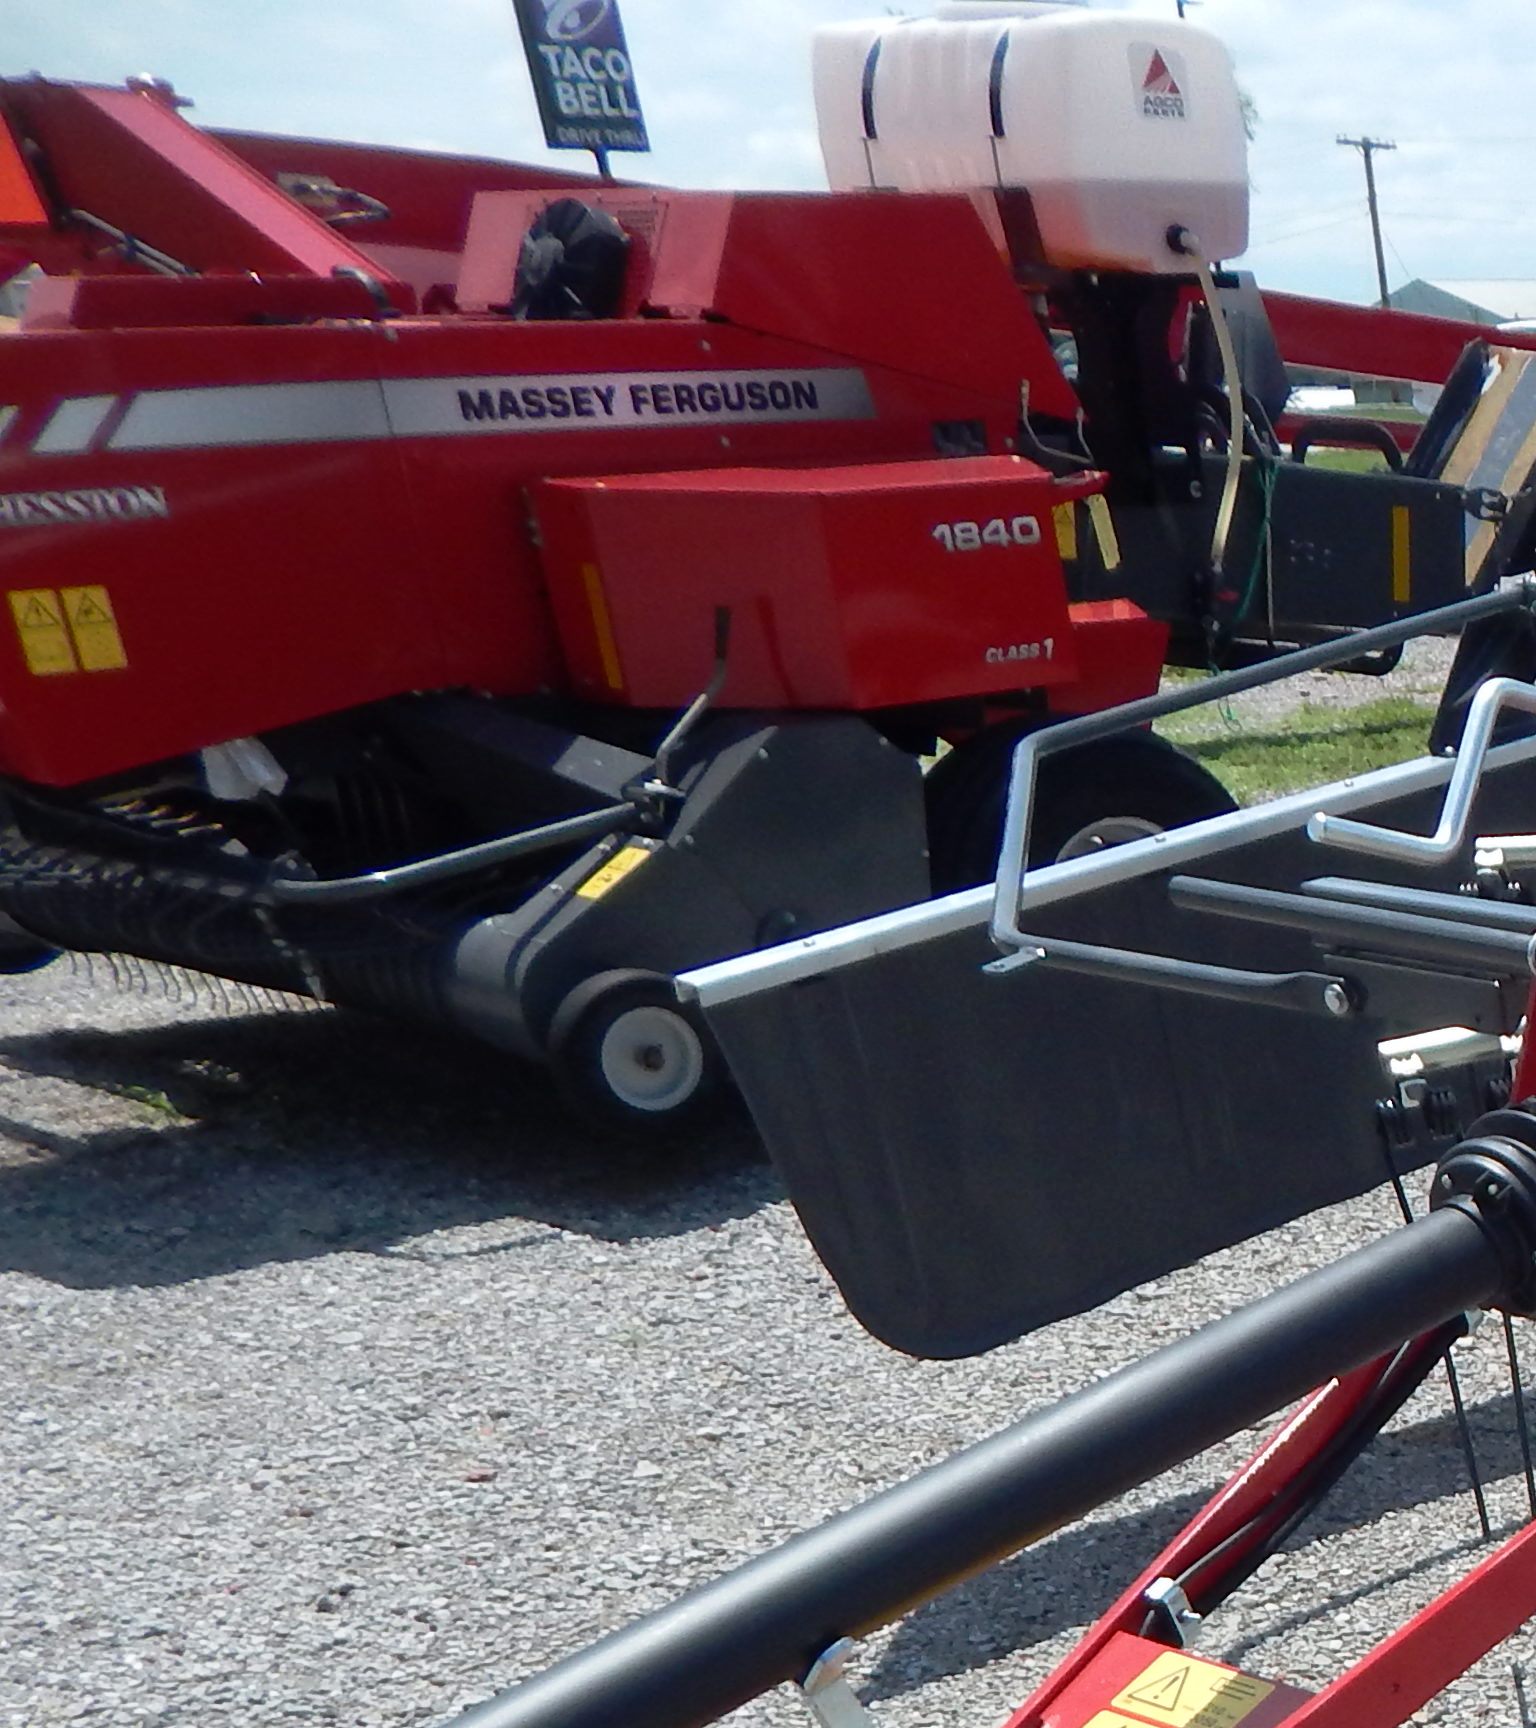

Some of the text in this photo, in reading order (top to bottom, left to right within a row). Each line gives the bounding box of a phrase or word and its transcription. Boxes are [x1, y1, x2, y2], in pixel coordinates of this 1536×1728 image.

[538, 45, 631, 82] TACO
[554, 80, 641, 118] BELL
[1143, 95, 1184, 108] AGCO
[457, 380, 819, 421] MASSEY FERGUSON
[932, 516, 1041, 552] 1840
[985, 637, 1054, 664] CLASS 1
